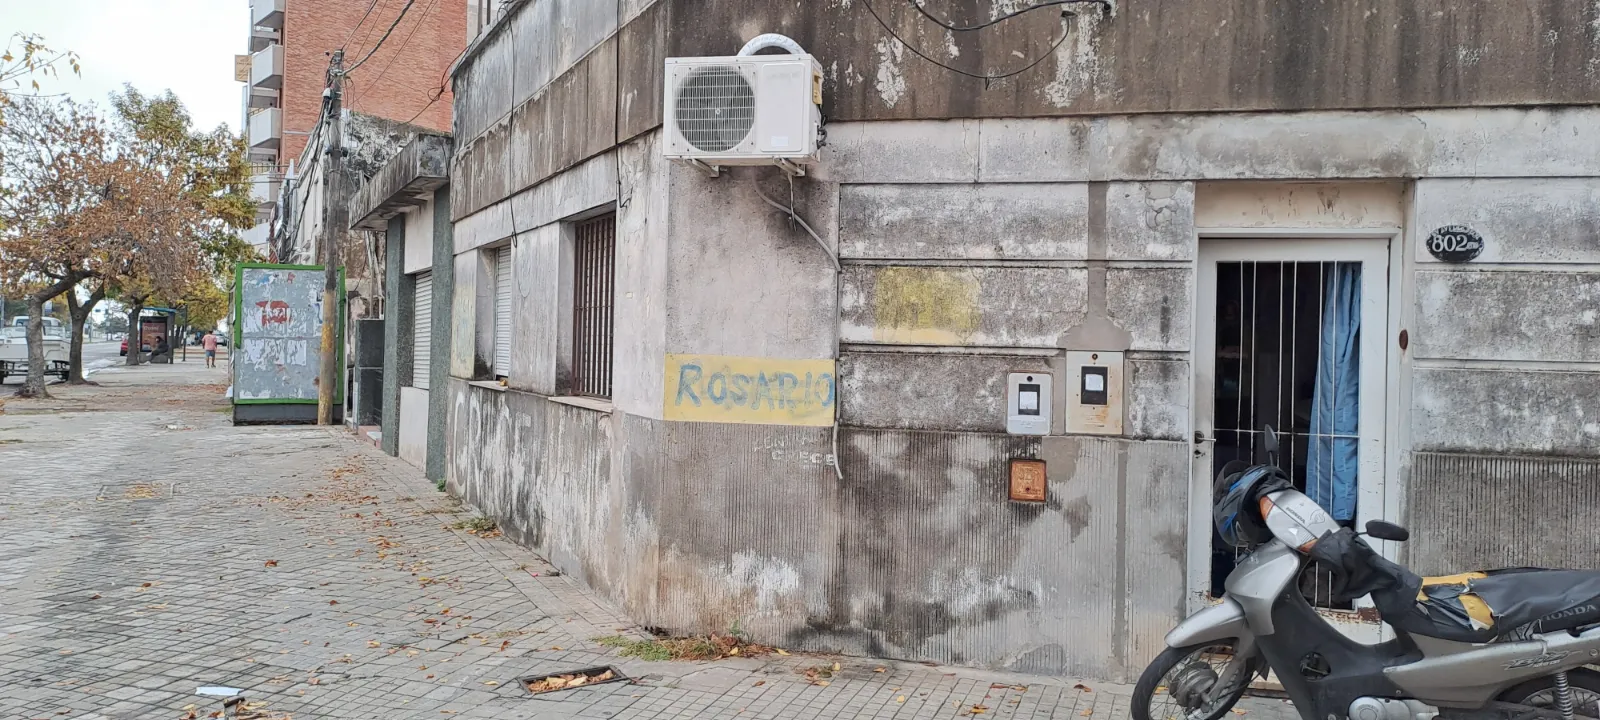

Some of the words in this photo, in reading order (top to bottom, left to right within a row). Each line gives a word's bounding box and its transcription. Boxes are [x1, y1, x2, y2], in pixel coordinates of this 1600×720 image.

[1432, 234, 1467, 252] 802
[675, 363, 835, 410] ROSARIO
[1285, 506, 1306, 524] HONDA
[1541, 604, 1597, 621] HONDA
